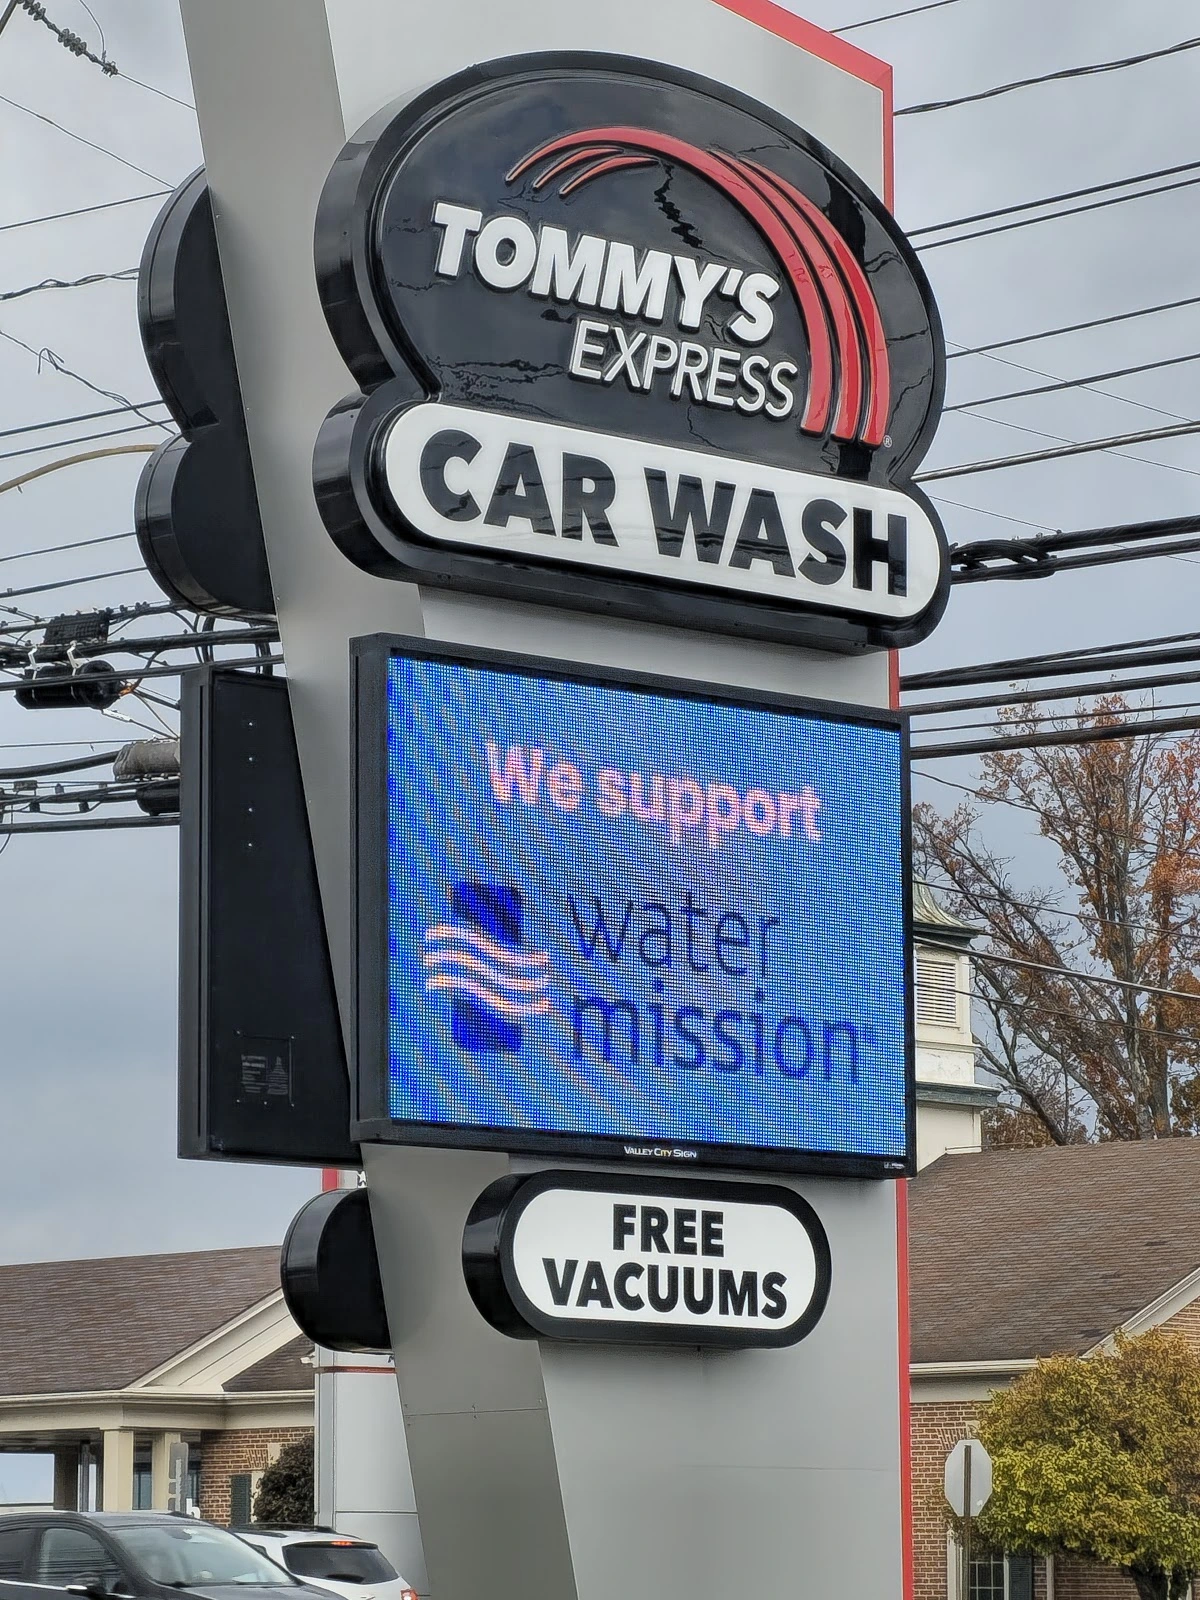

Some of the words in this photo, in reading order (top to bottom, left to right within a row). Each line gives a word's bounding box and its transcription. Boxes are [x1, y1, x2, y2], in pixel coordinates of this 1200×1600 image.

[434, 202, 780, 343] TOMMY'S
[570, 318, 799, 418] EXPRESS
[419, 429, 619, 547] CAR
[644, 468, 908, 596] WASH
[485, 741, 584, 812] We
[597, 769, 822, 847] support
[568, 892, 780, 977] water
[573, 982, 861, 1083] mission
[624, 1145, 653, 1156] VALLEY
[673, 1149, 697, 1158] SIGN
[612, 1203, 725, 1257] FREE
[541, 1257, 787, 1319] VACUUMS
